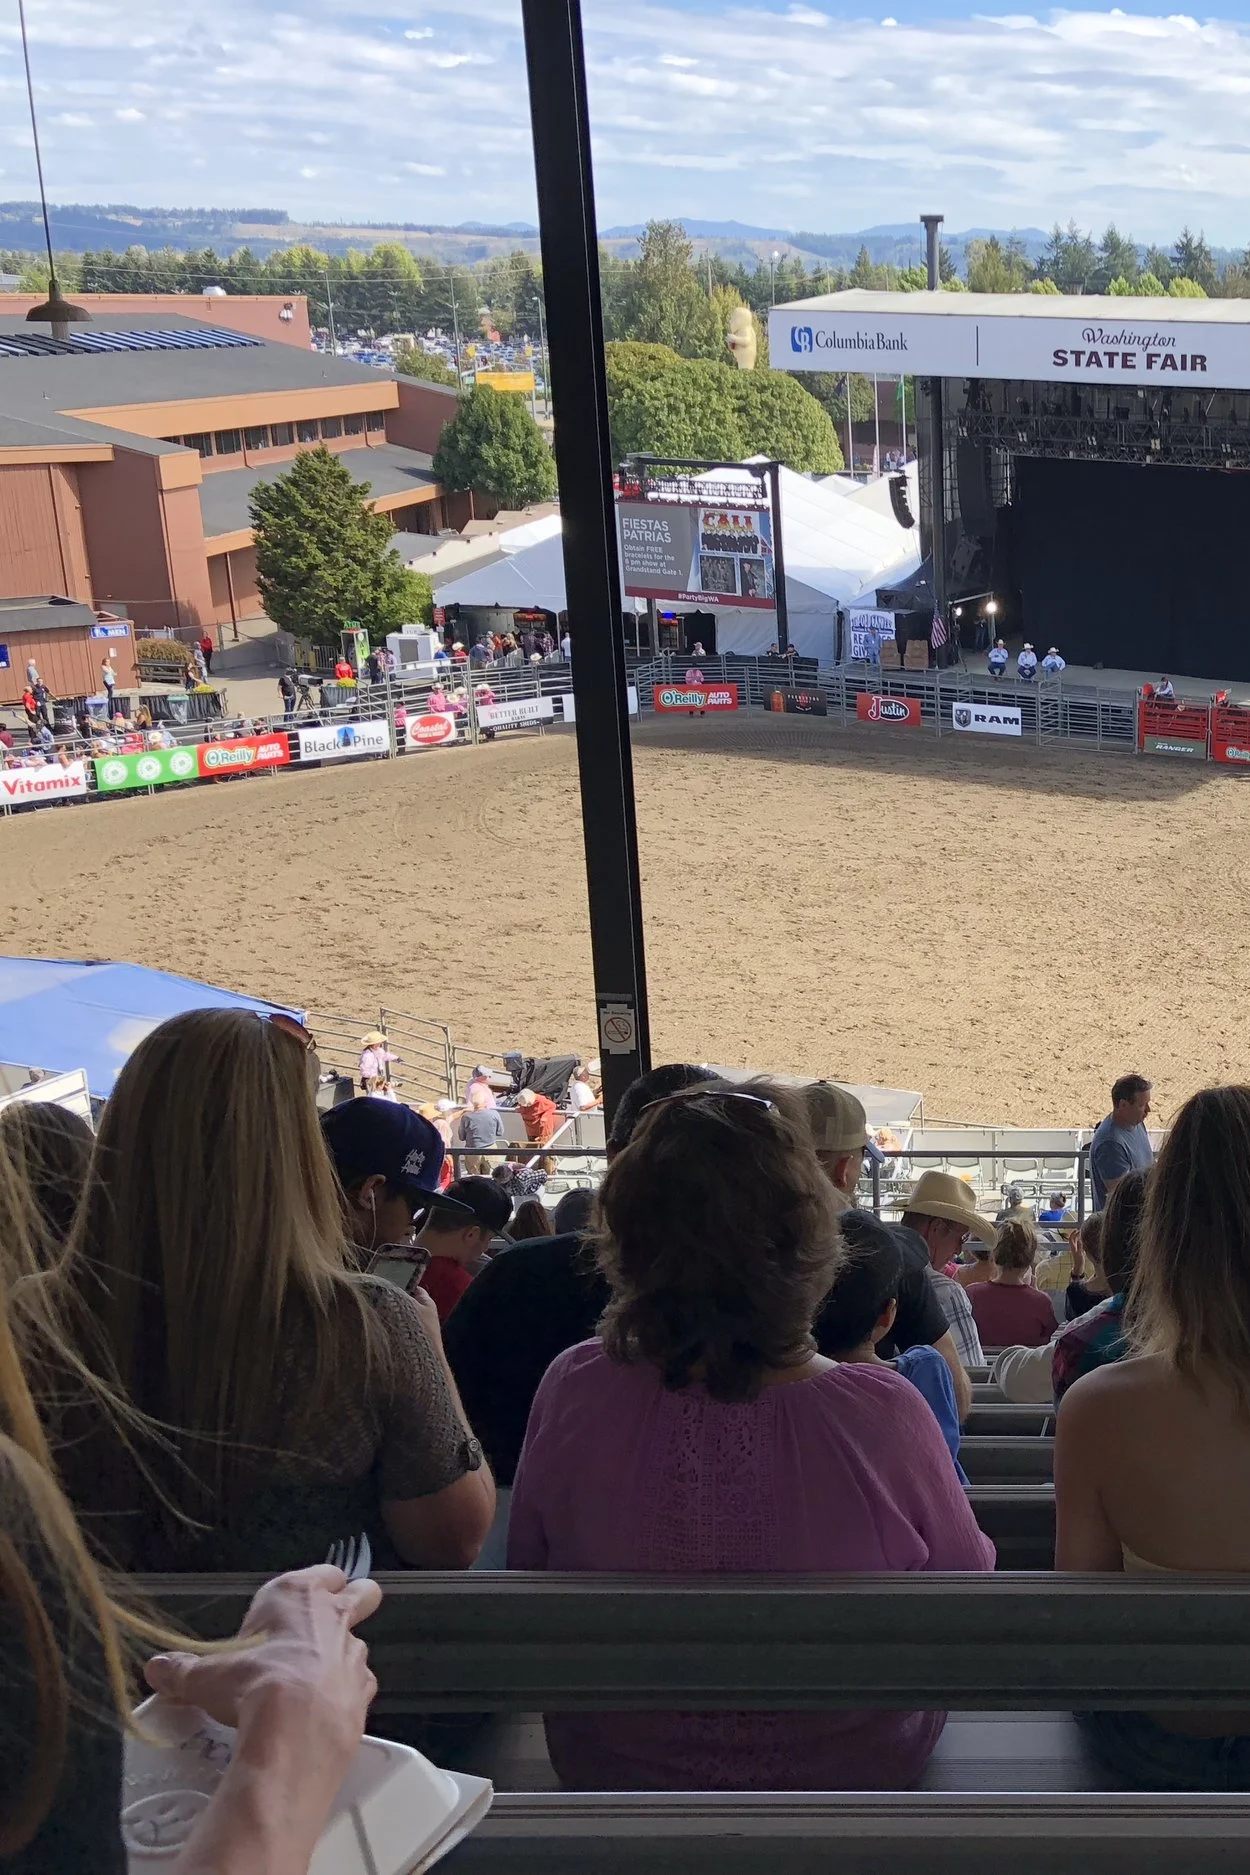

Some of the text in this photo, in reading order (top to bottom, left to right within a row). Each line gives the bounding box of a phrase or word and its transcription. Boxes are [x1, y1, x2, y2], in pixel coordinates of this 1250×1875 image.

[1081, 327, 1177, 352] Washington
[1051, 349, 1208, 373] STATE FAIR
[622, 517, 669, 532] FIESTAS
[702, 511, 753, 532] CALI
[622, 529, 672, 543] PATRIAS
[624, 544, 664, 554] Obtain FREE
[624, 551, 675, 561] bracelets for the
[625, 565, 661, 575] Grandstand
[662, 568, 678, 576] Gate
[661, 690, 705, 706] O'Reilly
[707, 697, 732, 705] PARTS
[868, 696, 907, 721] Justin
[974, 713, 1020, 726] RAM
[258, 743, 281, 753] AUTO
[304, 740, 341, 753] Black
[354, 735, 384, 748] Pine
[1155, 744, 1195, 753] RANGER
[206, 748, 254, 766] O'Reilly
[257, 749, 283, 760] PARTS
[2, 775, 81, 795] Vitamix
